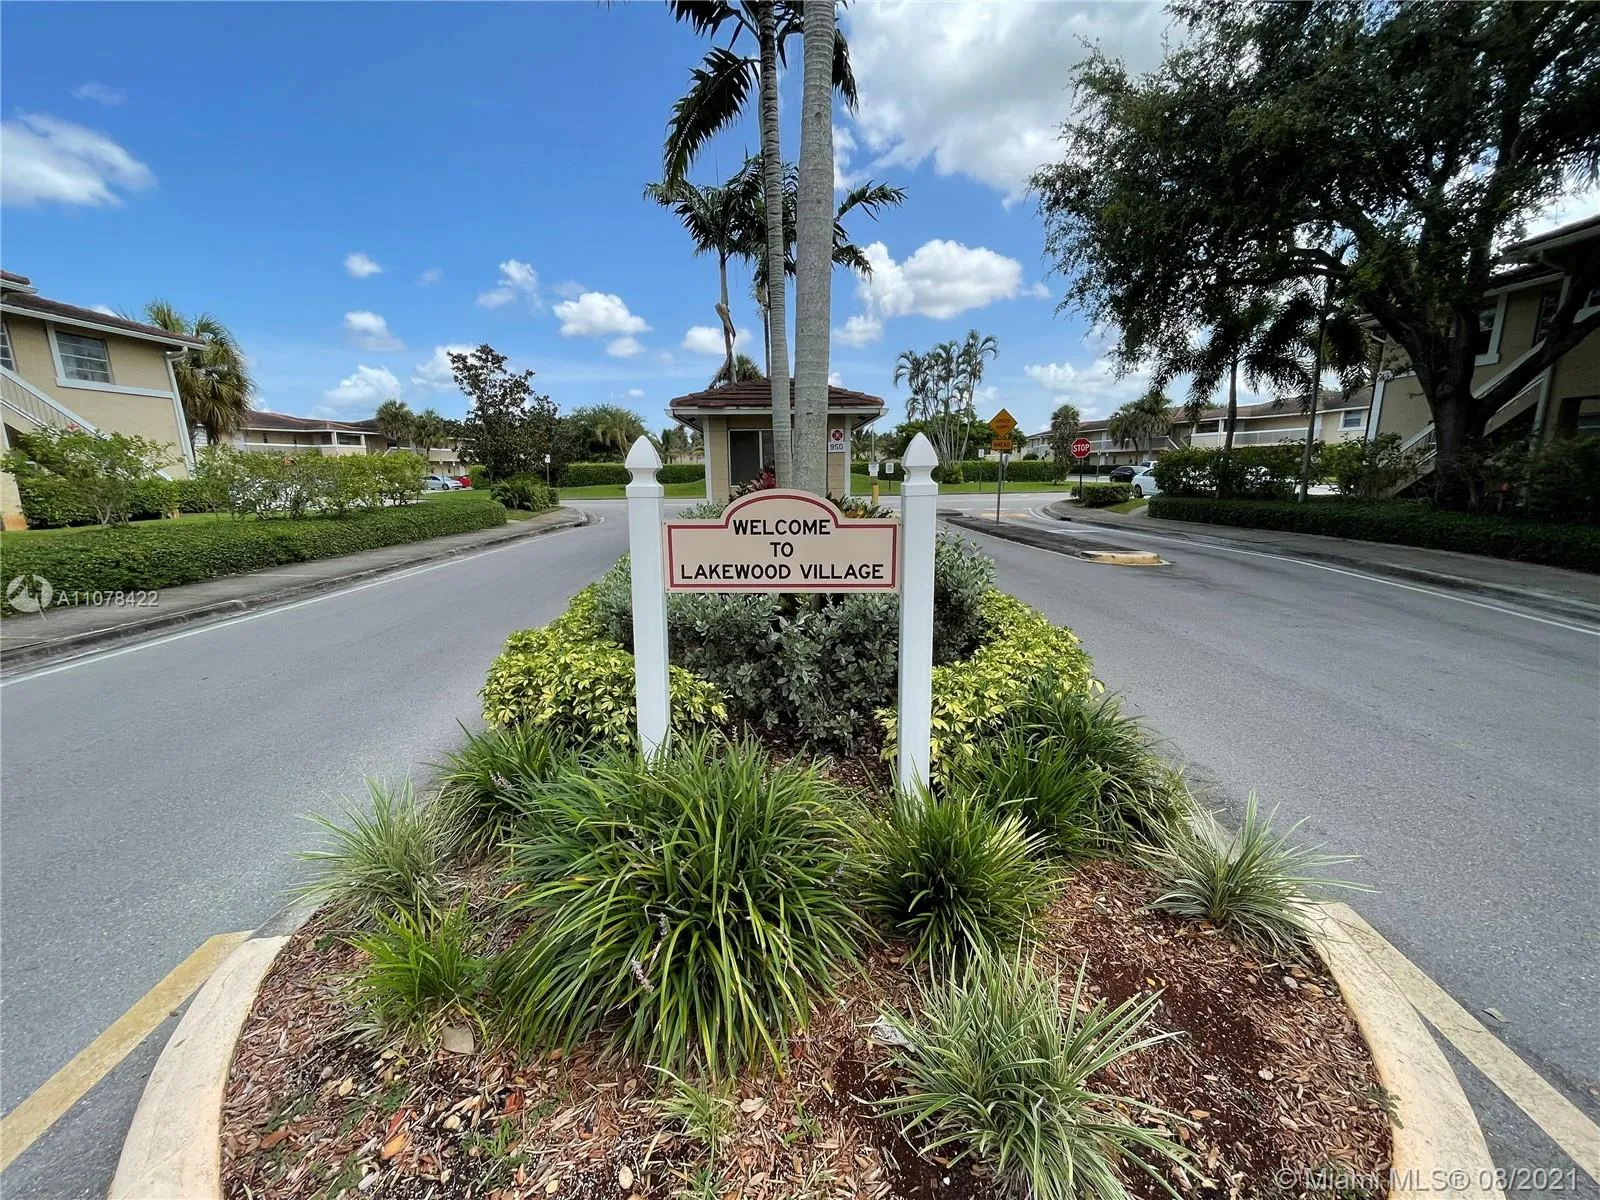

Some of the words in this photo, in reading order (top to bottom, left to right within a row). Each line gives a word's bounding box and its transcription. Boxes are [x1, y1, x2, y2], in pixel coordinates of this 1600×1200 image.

[829, 443, 844, 451] 950
[1073, 443, 1090, 453] STOP
[733, 519, 831, 535] WELCOME
[769, 541, 794, 557] TO
[680, 563, 791, 579] LAKEWOOD
[800, 563, 884, 579] VILLAGE
